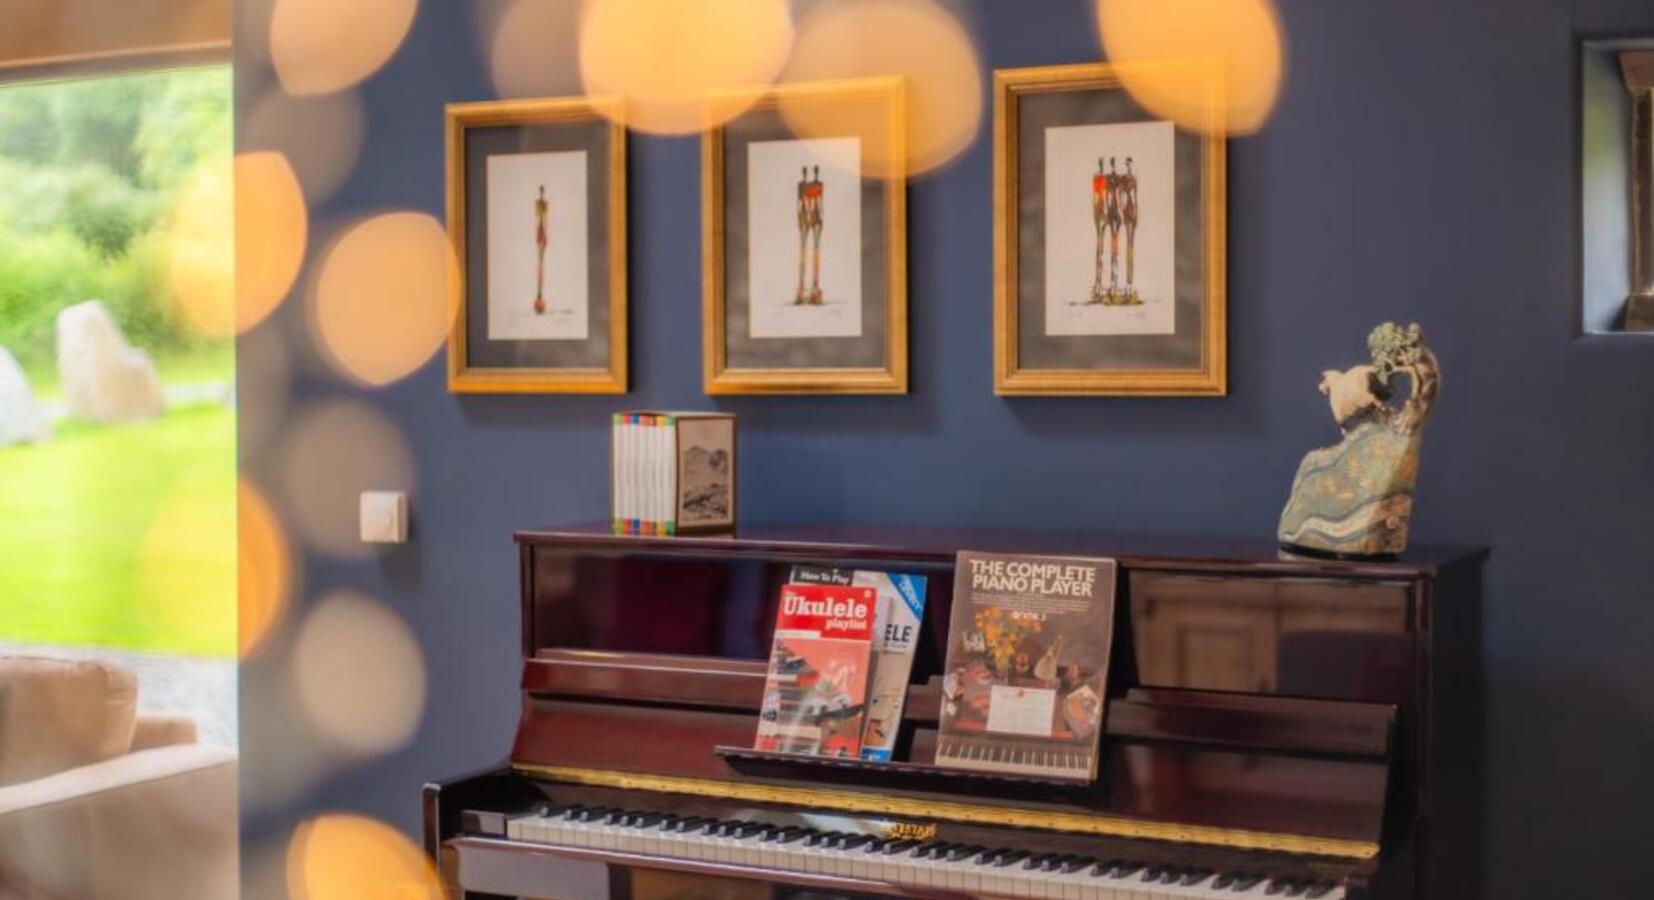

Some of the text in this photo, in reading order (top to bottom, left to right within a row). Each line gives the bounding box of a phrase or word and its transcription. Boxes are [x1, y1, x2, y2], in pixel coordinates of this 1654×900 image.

[970, 559, 1096, 583] THE COMPLETE
[972, 574, 1093, 597] PIANO PLAYER
[783, 595, 868, 619] Ukulele
[824, 617, 867, 632] playlist
